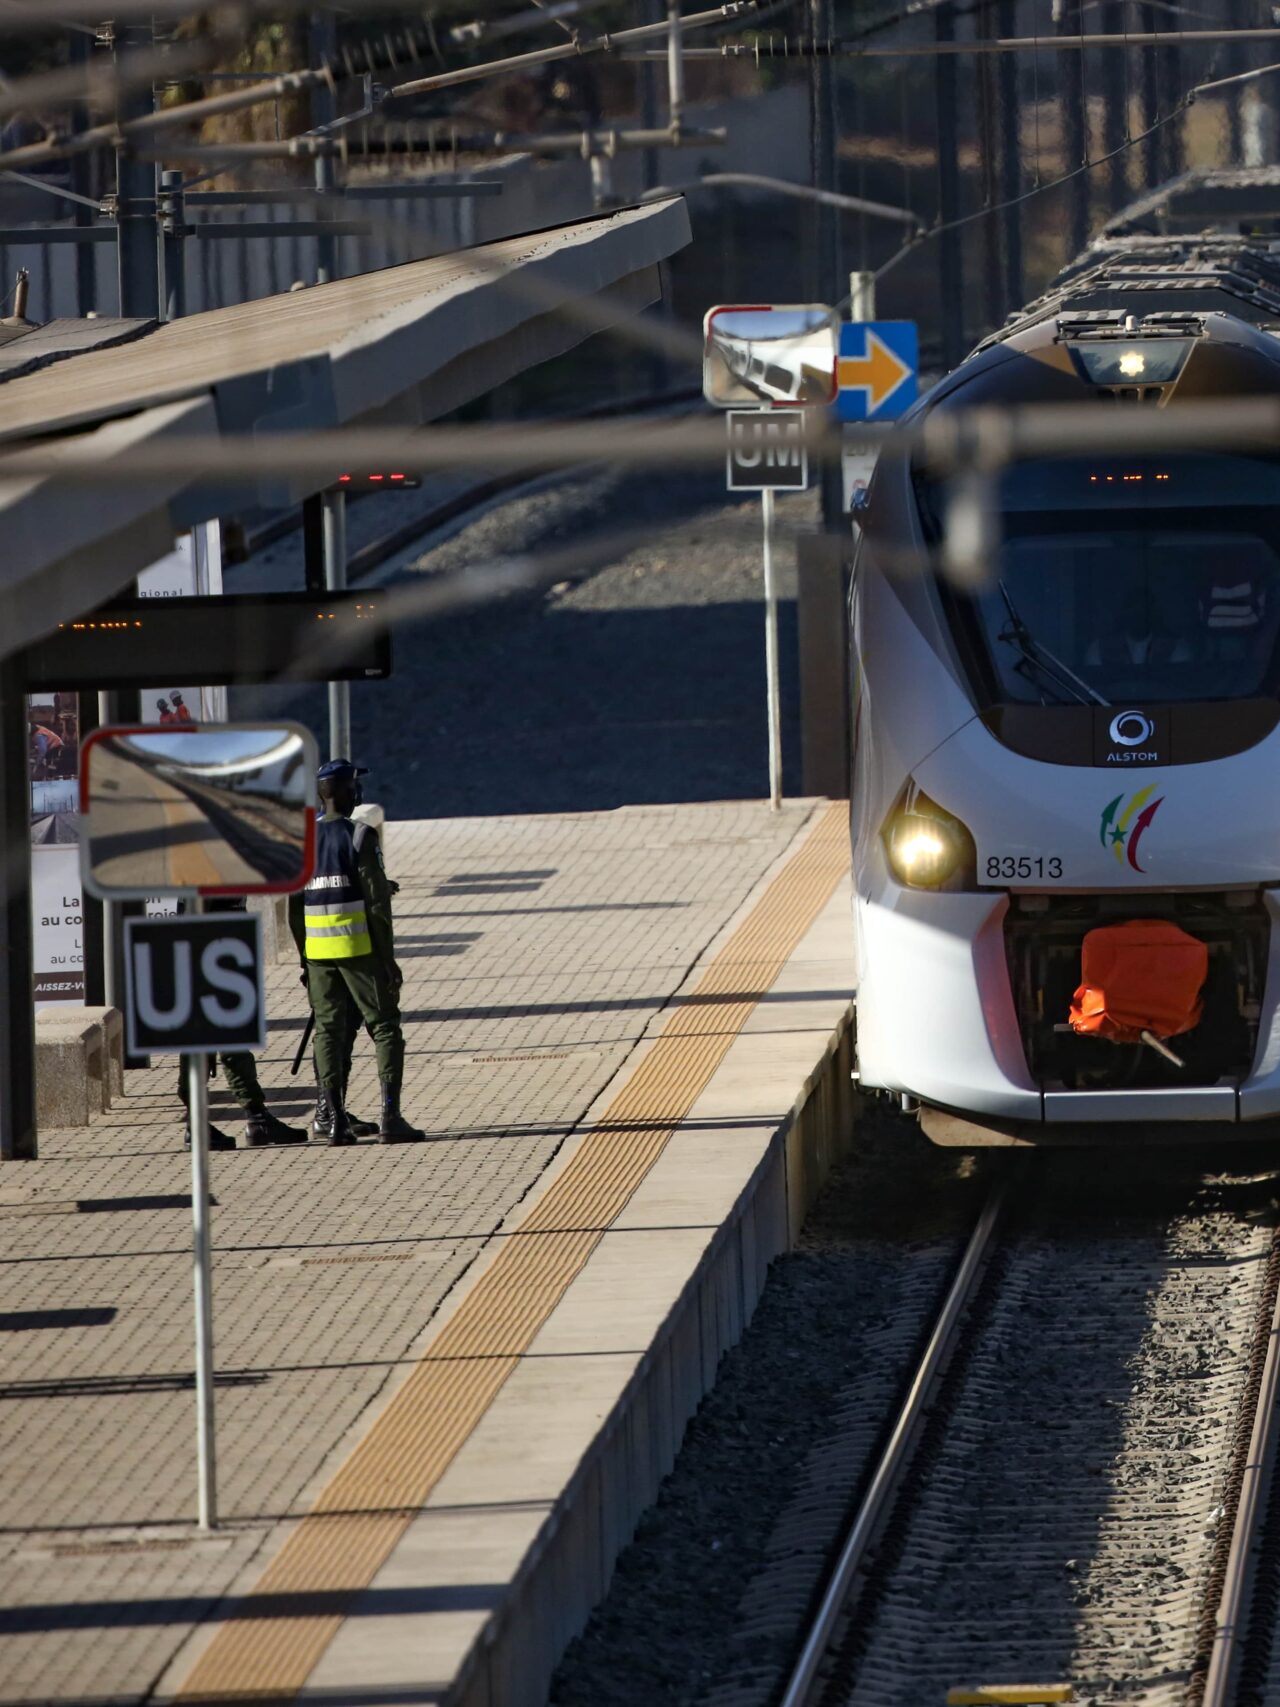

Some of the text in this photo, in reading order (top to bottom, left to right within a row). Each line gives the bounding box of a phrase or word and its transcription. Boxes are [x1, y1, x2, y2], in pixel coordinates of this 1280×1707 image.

[735, 423, 800, 468] UM
[1106, 752, 1158, 762] ALSTOM
[986, 856, 1063, 879] 83513
[62, 896, 80, 908] La
[41, 916, 60, 926] au
[50, 956, 66, 965] au
[134, 937, 257, 1032] US
